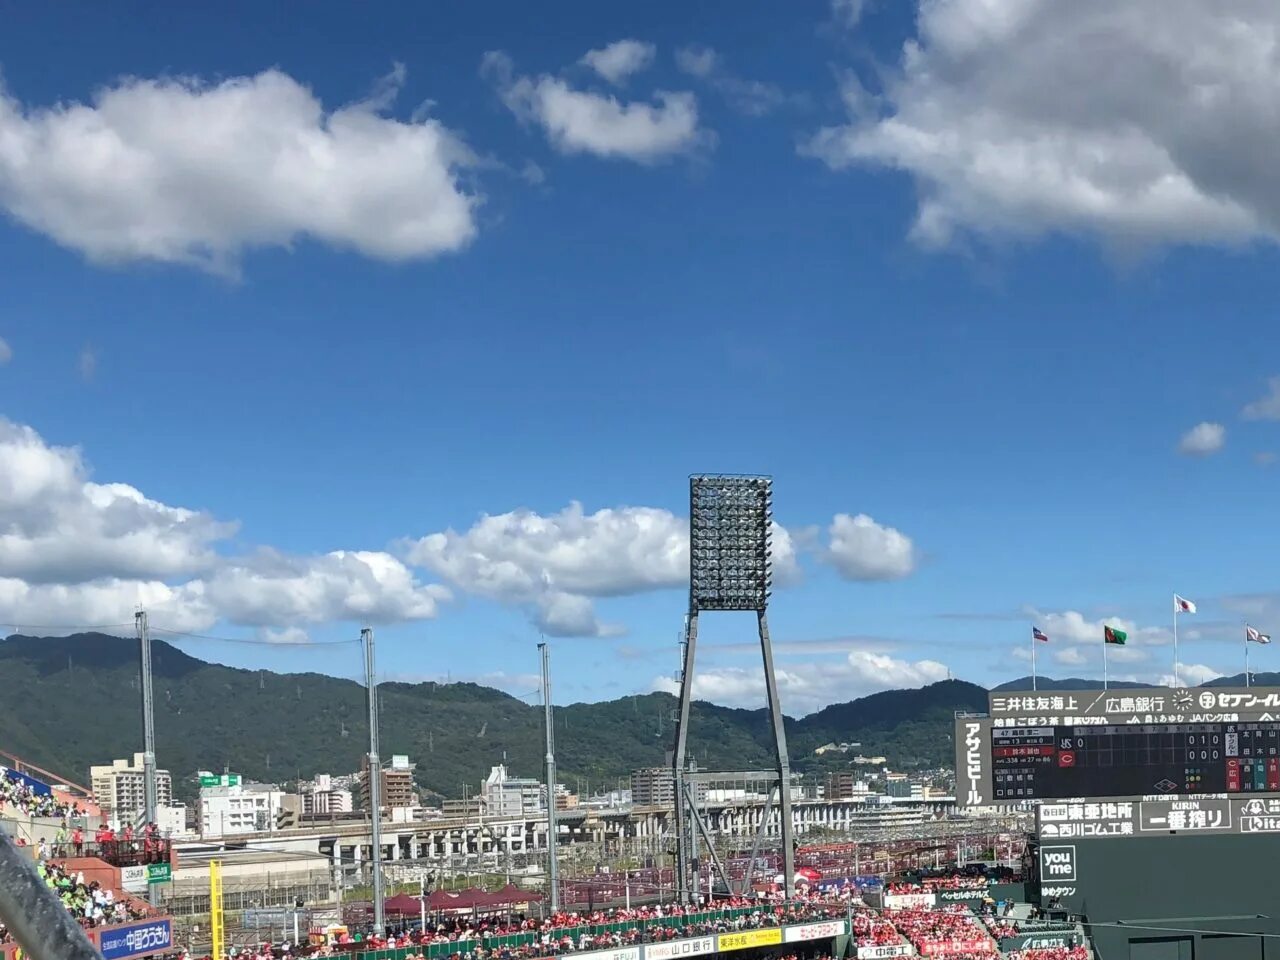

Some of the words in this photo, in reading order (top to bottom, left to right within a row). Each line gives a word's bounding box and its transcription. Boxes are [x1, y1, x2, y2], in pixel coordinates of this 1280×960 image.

[993, 696, 1078, 711] 三井住友海上
[1105, 697, 1165, 713] 広島銀行
[1078, 738, 1083, 747] 0
[1189, 736, 1194, 744] 0
[1213, 735, 1218, 744] 0
[1189, 751, 1195, 759] 0
[1201, 751, 1206, 759] 0
[1213, 750, 1218, 759] 0
[965, 723, 982, 805] アサヒビール
[1043, 807, 1067, 818] 春日野
[1068, 803, 1132, 819] 東亜地所
[1171, 802, 1199, 810] KIRIN
[1150, 810, 1222, 829] 一番搾り
[1059, 822, 1133, 836] 西川ゴム工業
[1045, 852, 1070, 865] you
[1050, 864, 1072, 874] me
[941, 890, 990, 900] ベッセルホテルズ
[1041, 886, 1076, 897] ゆめタウン
[126, 925, 170, 951] 中国ろうきん
[720, 936, 747, 948] 東洋水産
[671, 941, 711, 955] 山口銀行
[875, 946, 908, 956] 中電工
